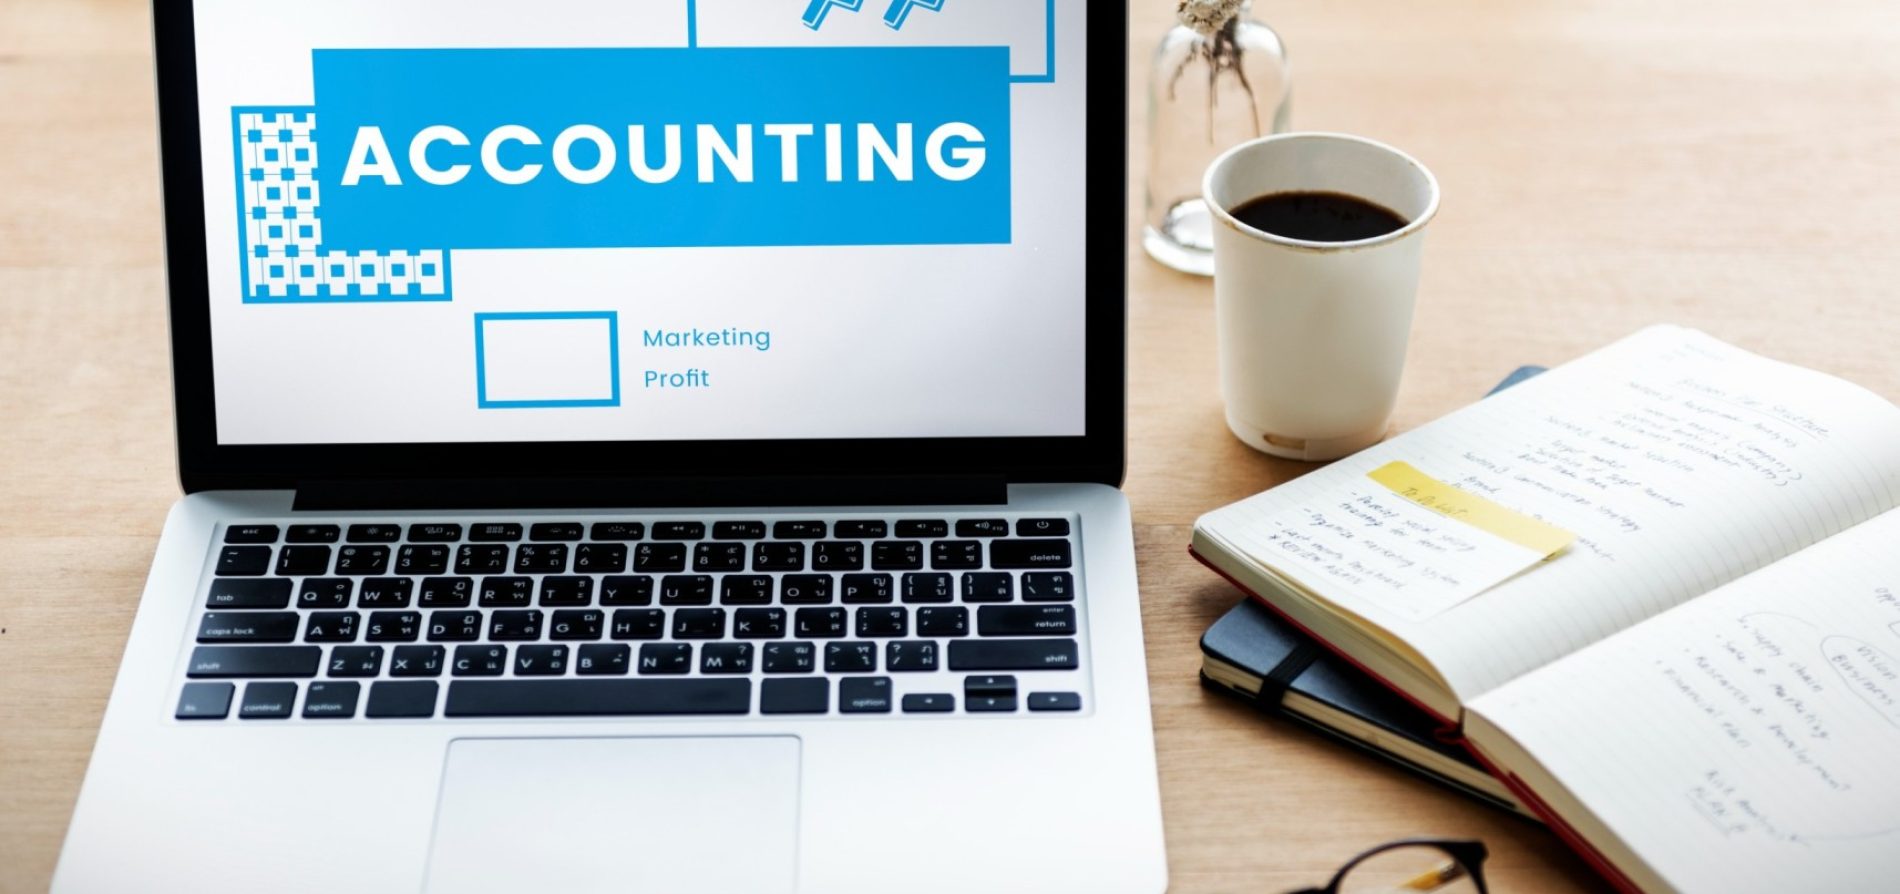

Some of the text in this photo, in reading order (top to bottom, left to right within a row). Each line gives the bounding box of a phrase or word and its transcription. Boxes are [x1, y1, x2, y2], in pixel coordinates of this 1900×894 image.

[342, 122, 985, 186] ACCOUNTING
[643, 327, 770, 351] Marketing
[644, 368, 709, 388] Profit
[341, 559, 350, 567] 2
[401, 558, 410, 566] 3
[521, 558, 530, 566] 5
[580, 557, 588, 565] 6
[641, 556, 648, 564] 7
[700, 556, 708, 564] 8
[303, 592, 317, 600] Q
[364, 592, 380, 600] W
[424, 591, 433, 600] E
[485, 590, 495, 599] R
[546, 590, 555, 598] T
[607, 589, 616, 598] Y
[666, 589, 678, 598] U
[787, 588, 800, 596] O
[848, 587, 857, 596] P
[310, 626, 323, 635] A
[372, 625, 381, 634] S
[433, 625, 445, 634] D
[494, 624, 503, 633] F
[556, 624, 569, 632] G
[617, 624, 630, 632] H
[679, 622, 686, 632] J
[740, 622, 750, 631] K
[801, 622, 809, 631] L
[332, 660, 344, 670] Z
[395, 660, 407, 668] X
[457, 660, 469, 669] C
[520, 659, 532, 668] V
[581, 658, 592, 668] B
[644, 657, 656, 667] N
[706, 657, 722, 666] M
[852, 699, 886, 707] option
[307, 704, 342, 712] option
